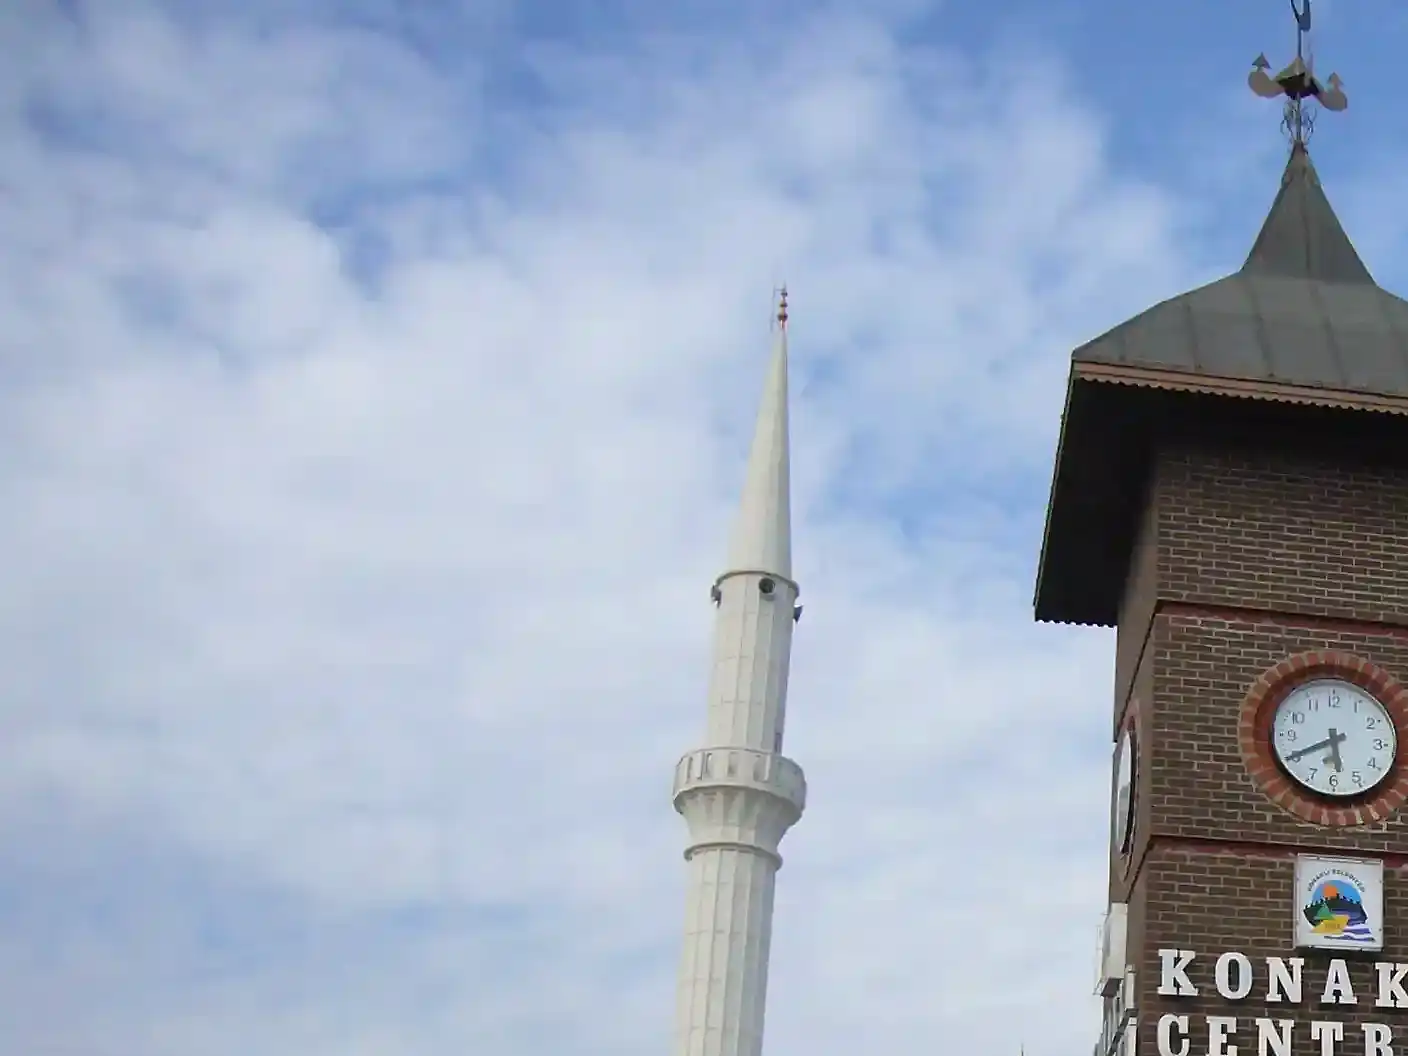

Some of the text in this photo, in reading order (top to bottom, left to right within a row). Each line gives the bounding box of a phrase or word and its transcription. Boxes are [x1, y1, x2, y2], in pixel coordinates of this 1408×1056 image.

[1308, 699, 1319, 712] 11
[1328, 695, 1341, 708] 12
[1291, 711, 1305, 724] 10
[1365, 717, 1376, 730] 2
[1287, 729, 1296, 742] 9
[1372, 738, 1383, 751] 3
[1367, 757, 1376, 769] 4
[1309, 767, 1318, 781] 7
[1329, 774, 1338, 787] 6
[1351, 771, 1361, 784] 5
